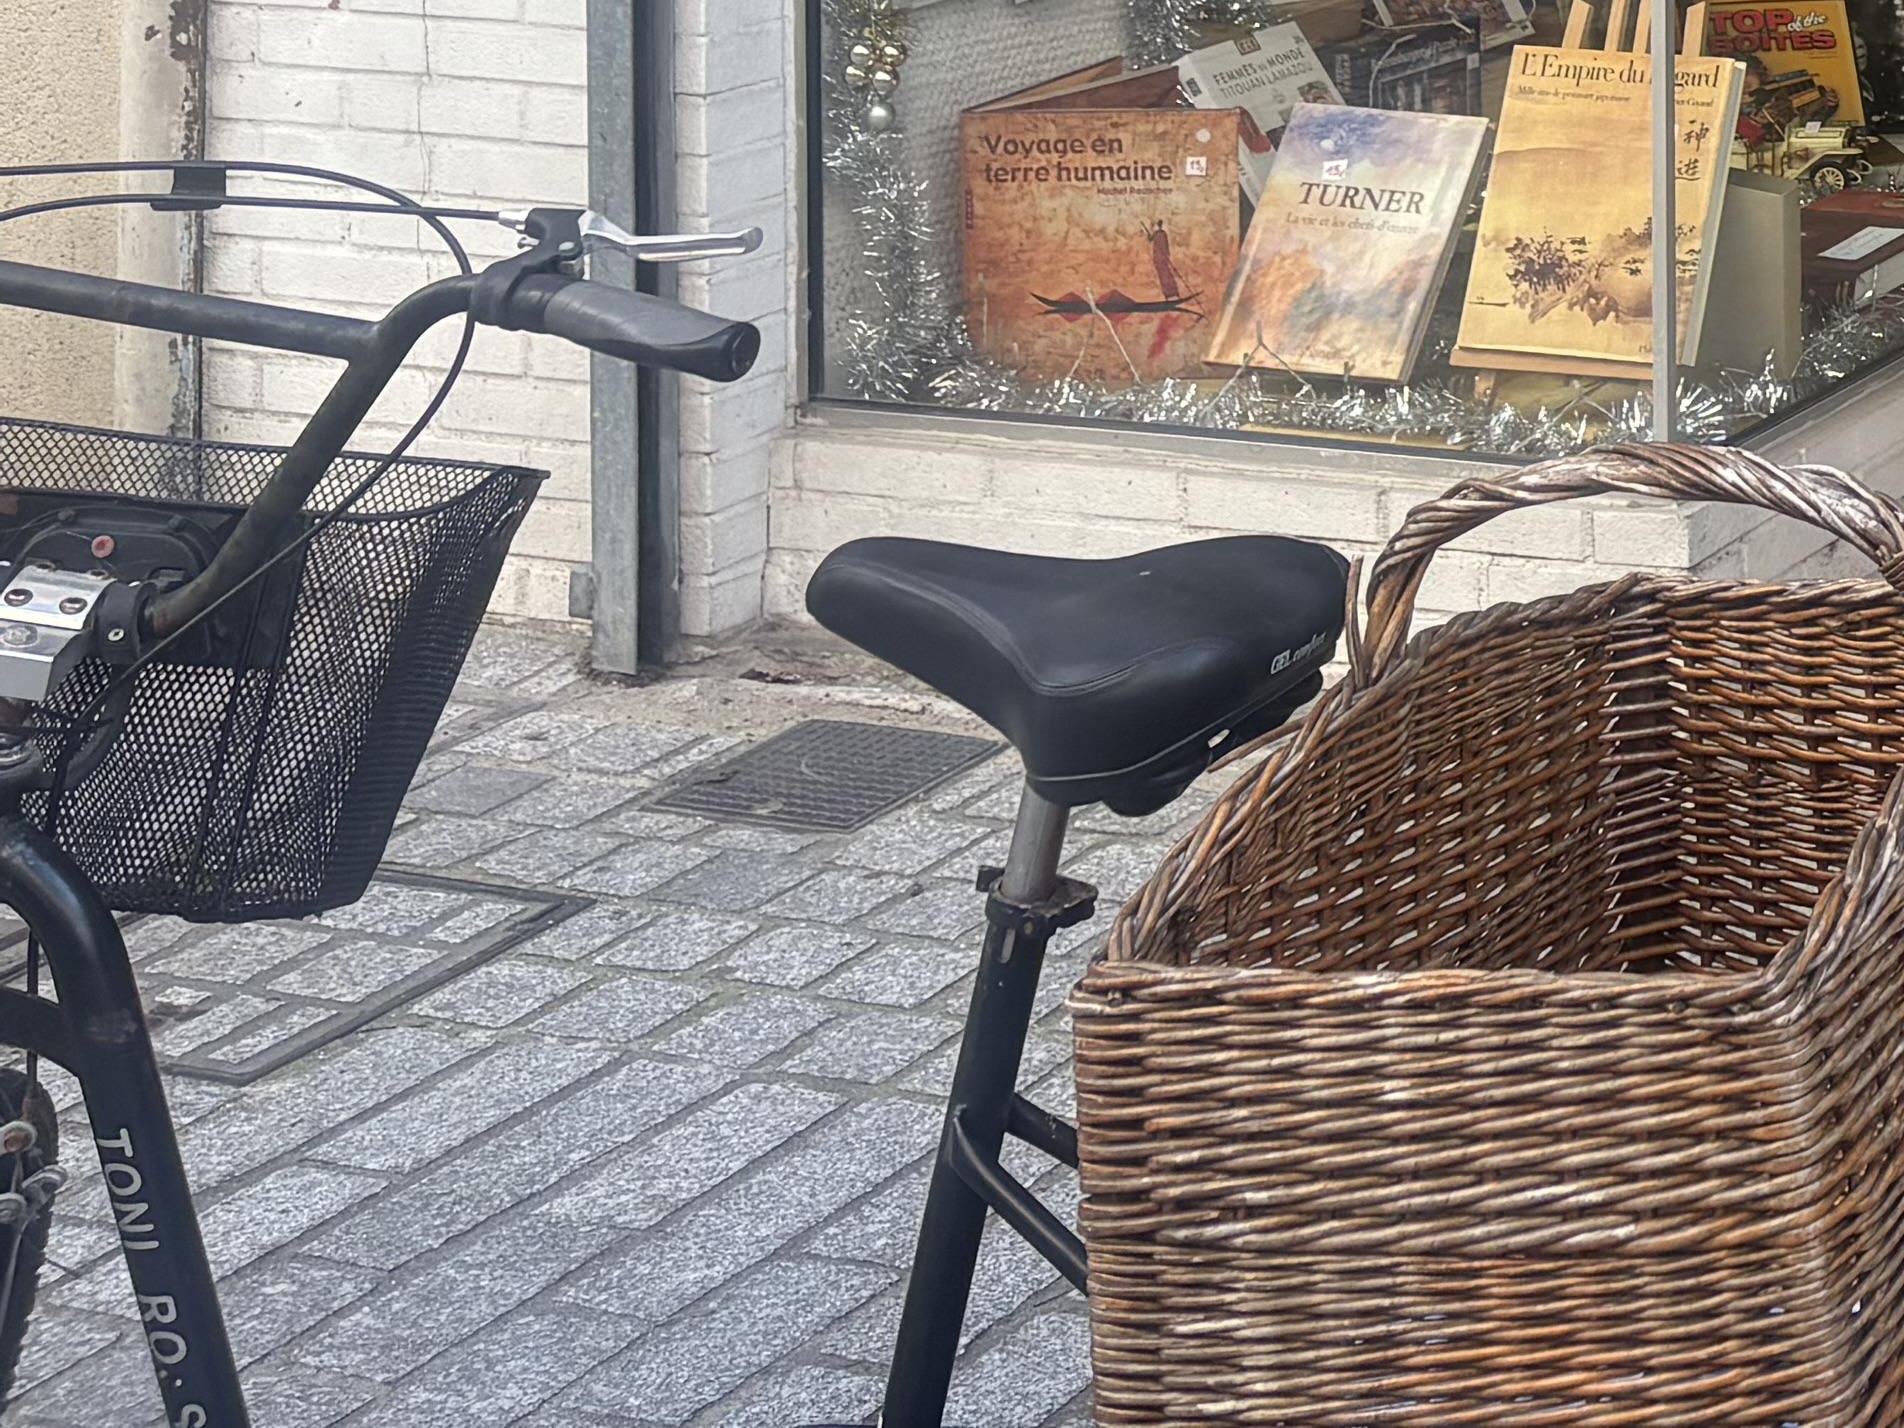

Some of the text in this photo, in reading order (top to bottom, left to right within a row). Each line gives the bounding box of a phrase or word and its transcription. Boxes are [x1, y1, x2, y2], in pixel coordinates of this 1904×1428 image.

[1710, 8, 1793, 34] TOP
[1711, 29, 1837, 54] BOITES
[1213, 63, 1257, 85] FEMMES
[1521, 52, 1615, 87] L'Empire
[1619, 60, 1645, 84] du
[985, 134, 1124, 159] Voyage en
[985, 160, 1173, 184] terre humaine
[1299, 182, 1424, 214] TURNER
[97, 1128, 160, 1251] TONI
